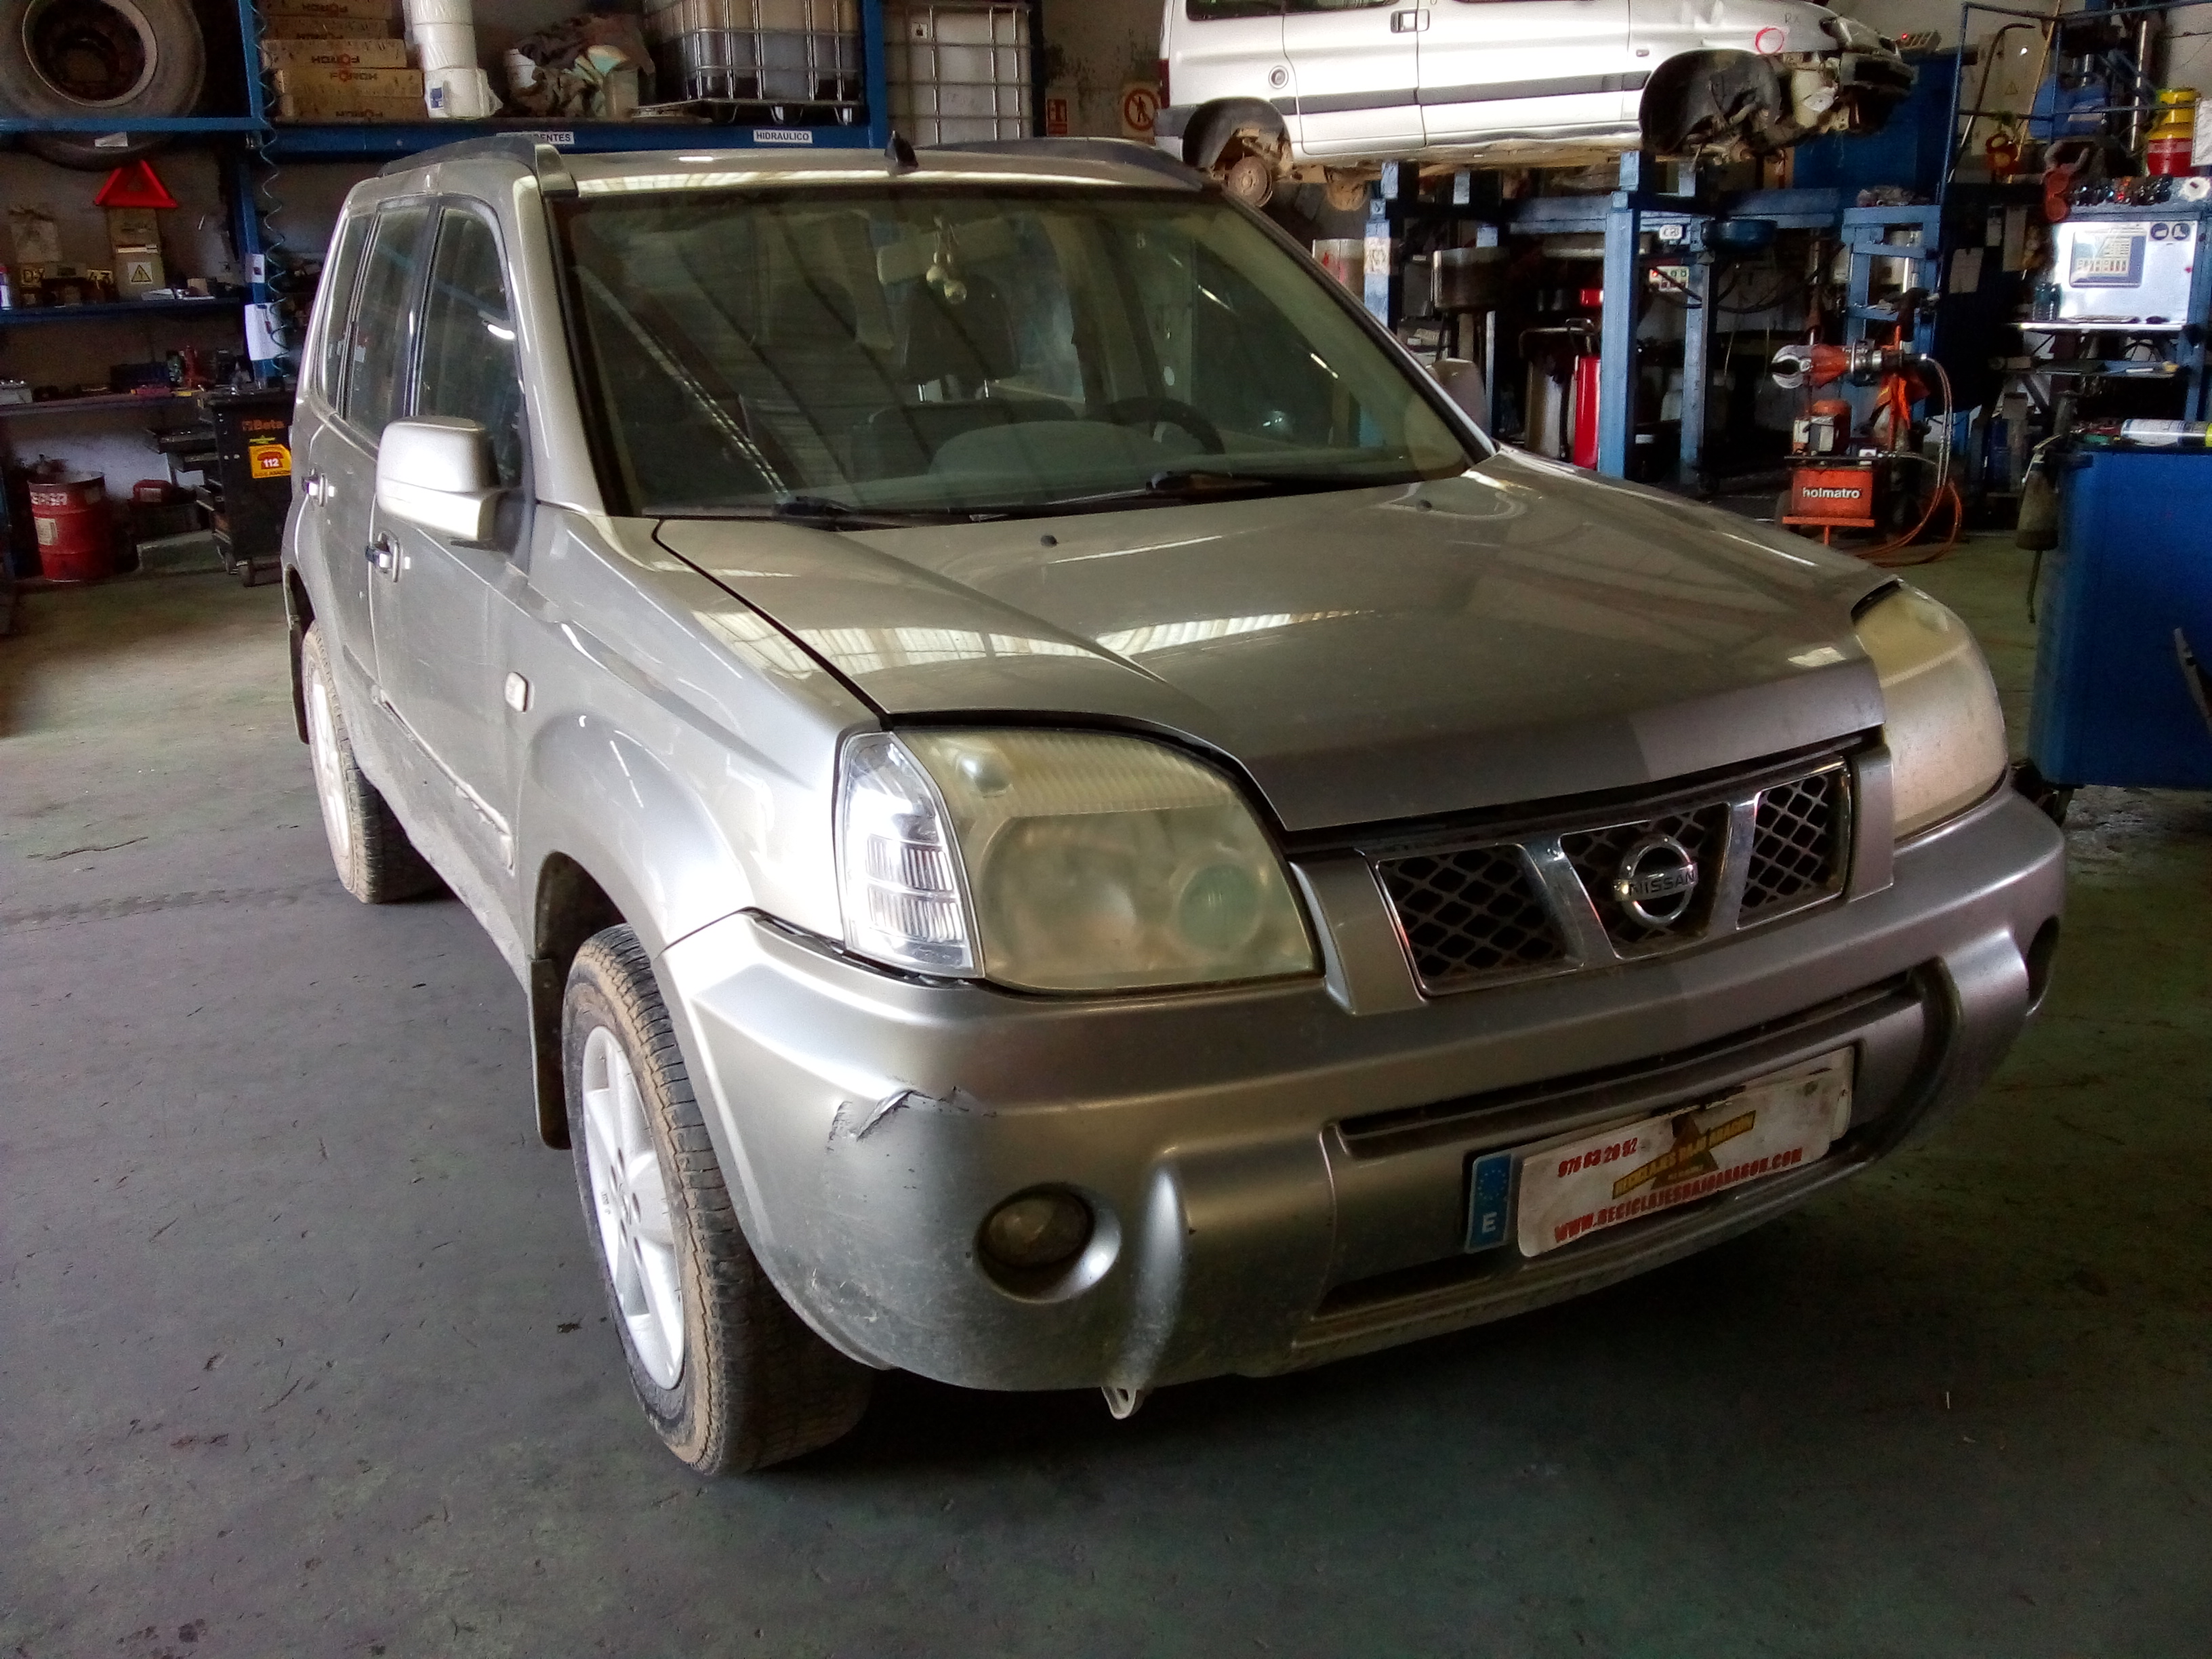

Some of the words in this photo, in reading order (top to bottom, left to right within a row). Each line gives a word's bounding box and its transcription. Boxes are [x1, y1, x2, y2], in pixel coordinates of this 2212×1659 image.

[756, 131, 810, 141] HIDRAULICO
[263, 458, 279, 468] 112
[1802, 487, 1861, 499] holmatro
[1628, 869, 1695, 896] NISSAN
[1481, 1212, 1497, 1233] E
